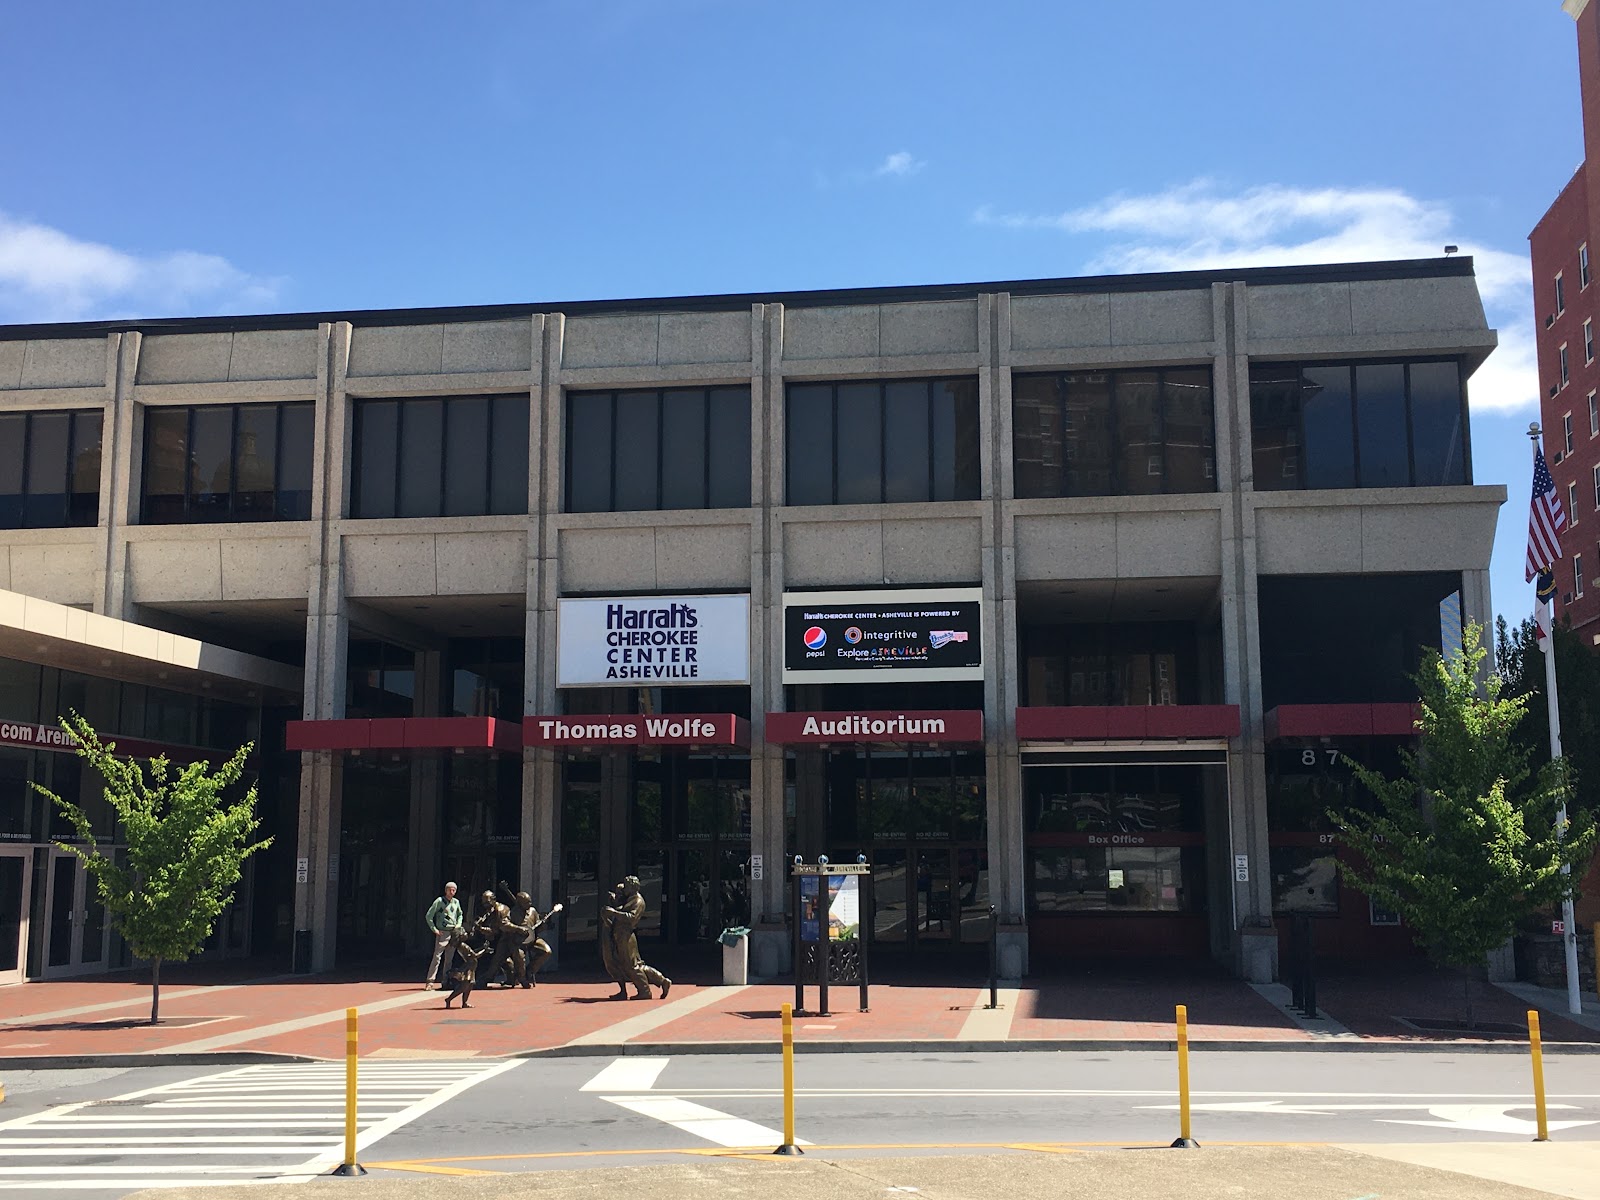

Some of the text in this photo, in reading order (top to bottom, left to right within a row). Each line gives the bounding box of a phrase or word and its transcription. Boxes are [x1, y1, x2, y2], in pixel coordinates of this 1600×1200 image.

[606, 603, 698, 629] Harrah's
[606, 630, 698, 646] CHEROKEE
[863, 630, 918, 642] integritive
[606, 647, 698, 664] CENTER
[806, 650, 825, 659] pepsi
[837, 648, 869, 659] Explore
[606, 665, 698, 679] ASHEVILLE
[539, 718, 716, 740] Thomas Wolfe
[802, 715, 946, 736] Auditorium
[1088, 835, 1145, 844] Box Office
